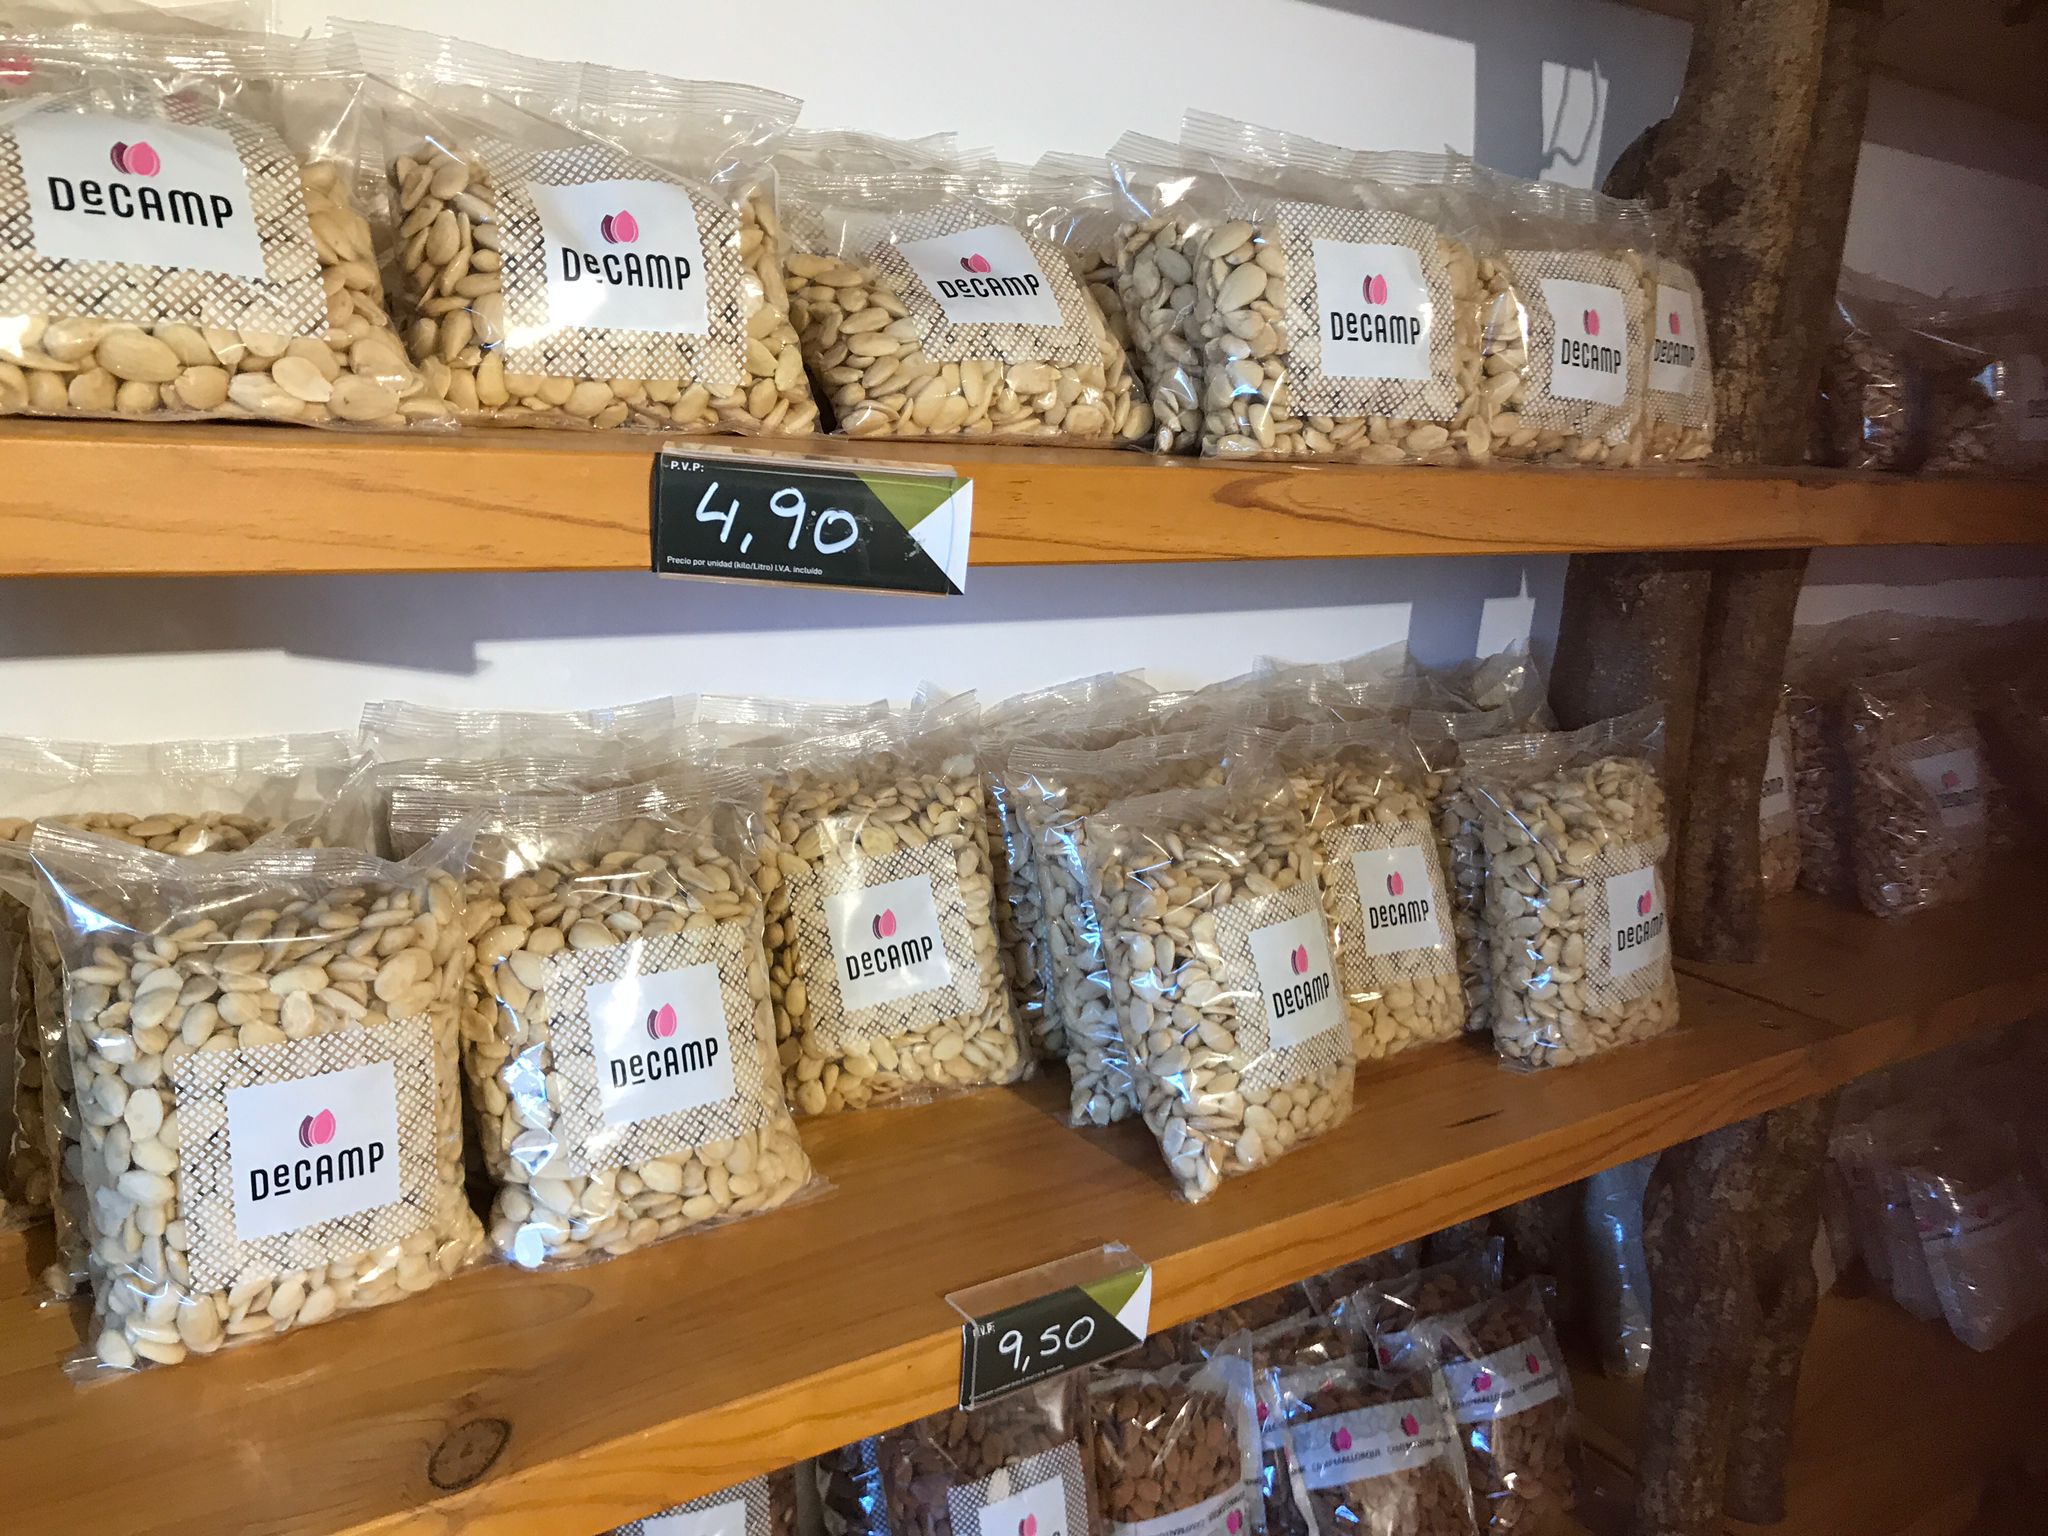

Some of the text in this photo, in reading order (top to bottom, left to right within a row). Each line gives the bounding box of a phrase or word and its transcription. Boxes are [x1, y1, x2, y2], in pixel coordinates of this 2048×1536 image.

[670, 460, 705, 473] P.V.P:
[695, 481, 859, 555] 4,90
[666, 555, 692, 566] Precio
[692, 558, 706, 568] por
[706, 559, 733, 569] unidad
[733, 560, 774, 572] (kilo/Litro)
[792, 566, 823, 576] incluido
[998, 1315, 1096, 1373] 9,50
